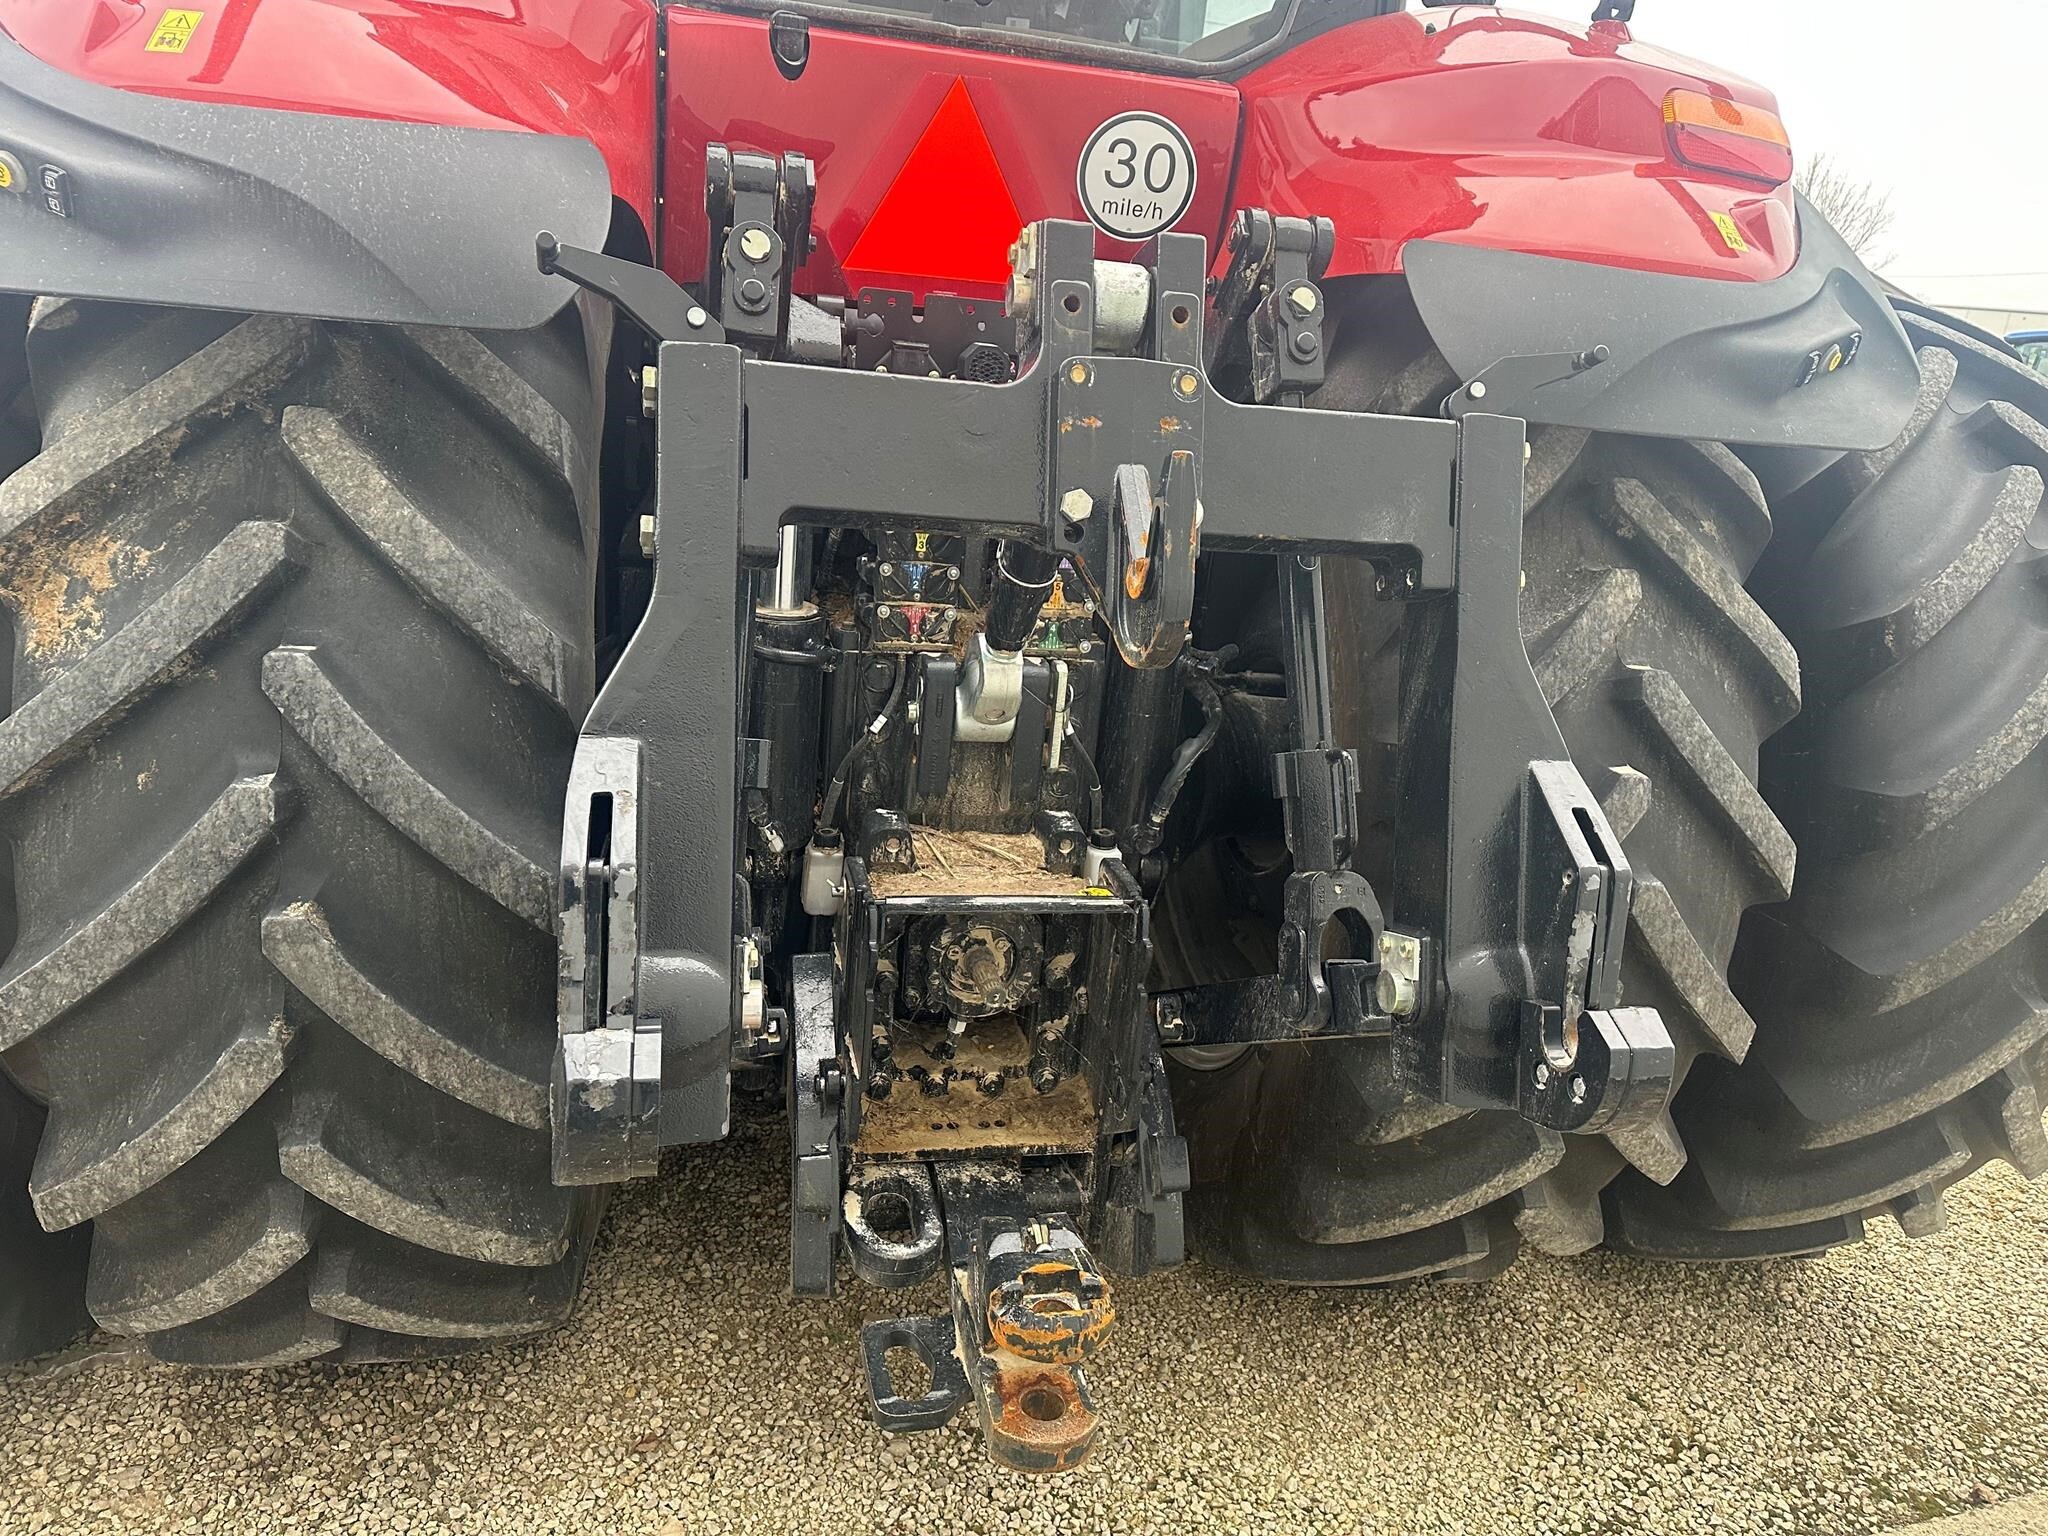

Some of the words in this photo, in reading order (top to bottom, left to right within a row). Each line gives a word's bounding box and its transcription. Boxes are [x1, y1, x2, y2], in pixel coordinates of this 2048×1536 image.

[1104, 137, 1177, 194] 30
[1101, 198, 1163, 220] mile/h
[918, 540, 924, 549] 3
[912, 580, 919, 589] 2
[1055, 583, 1061, 591] 5
[1050, 624, 1057, 632] 4
